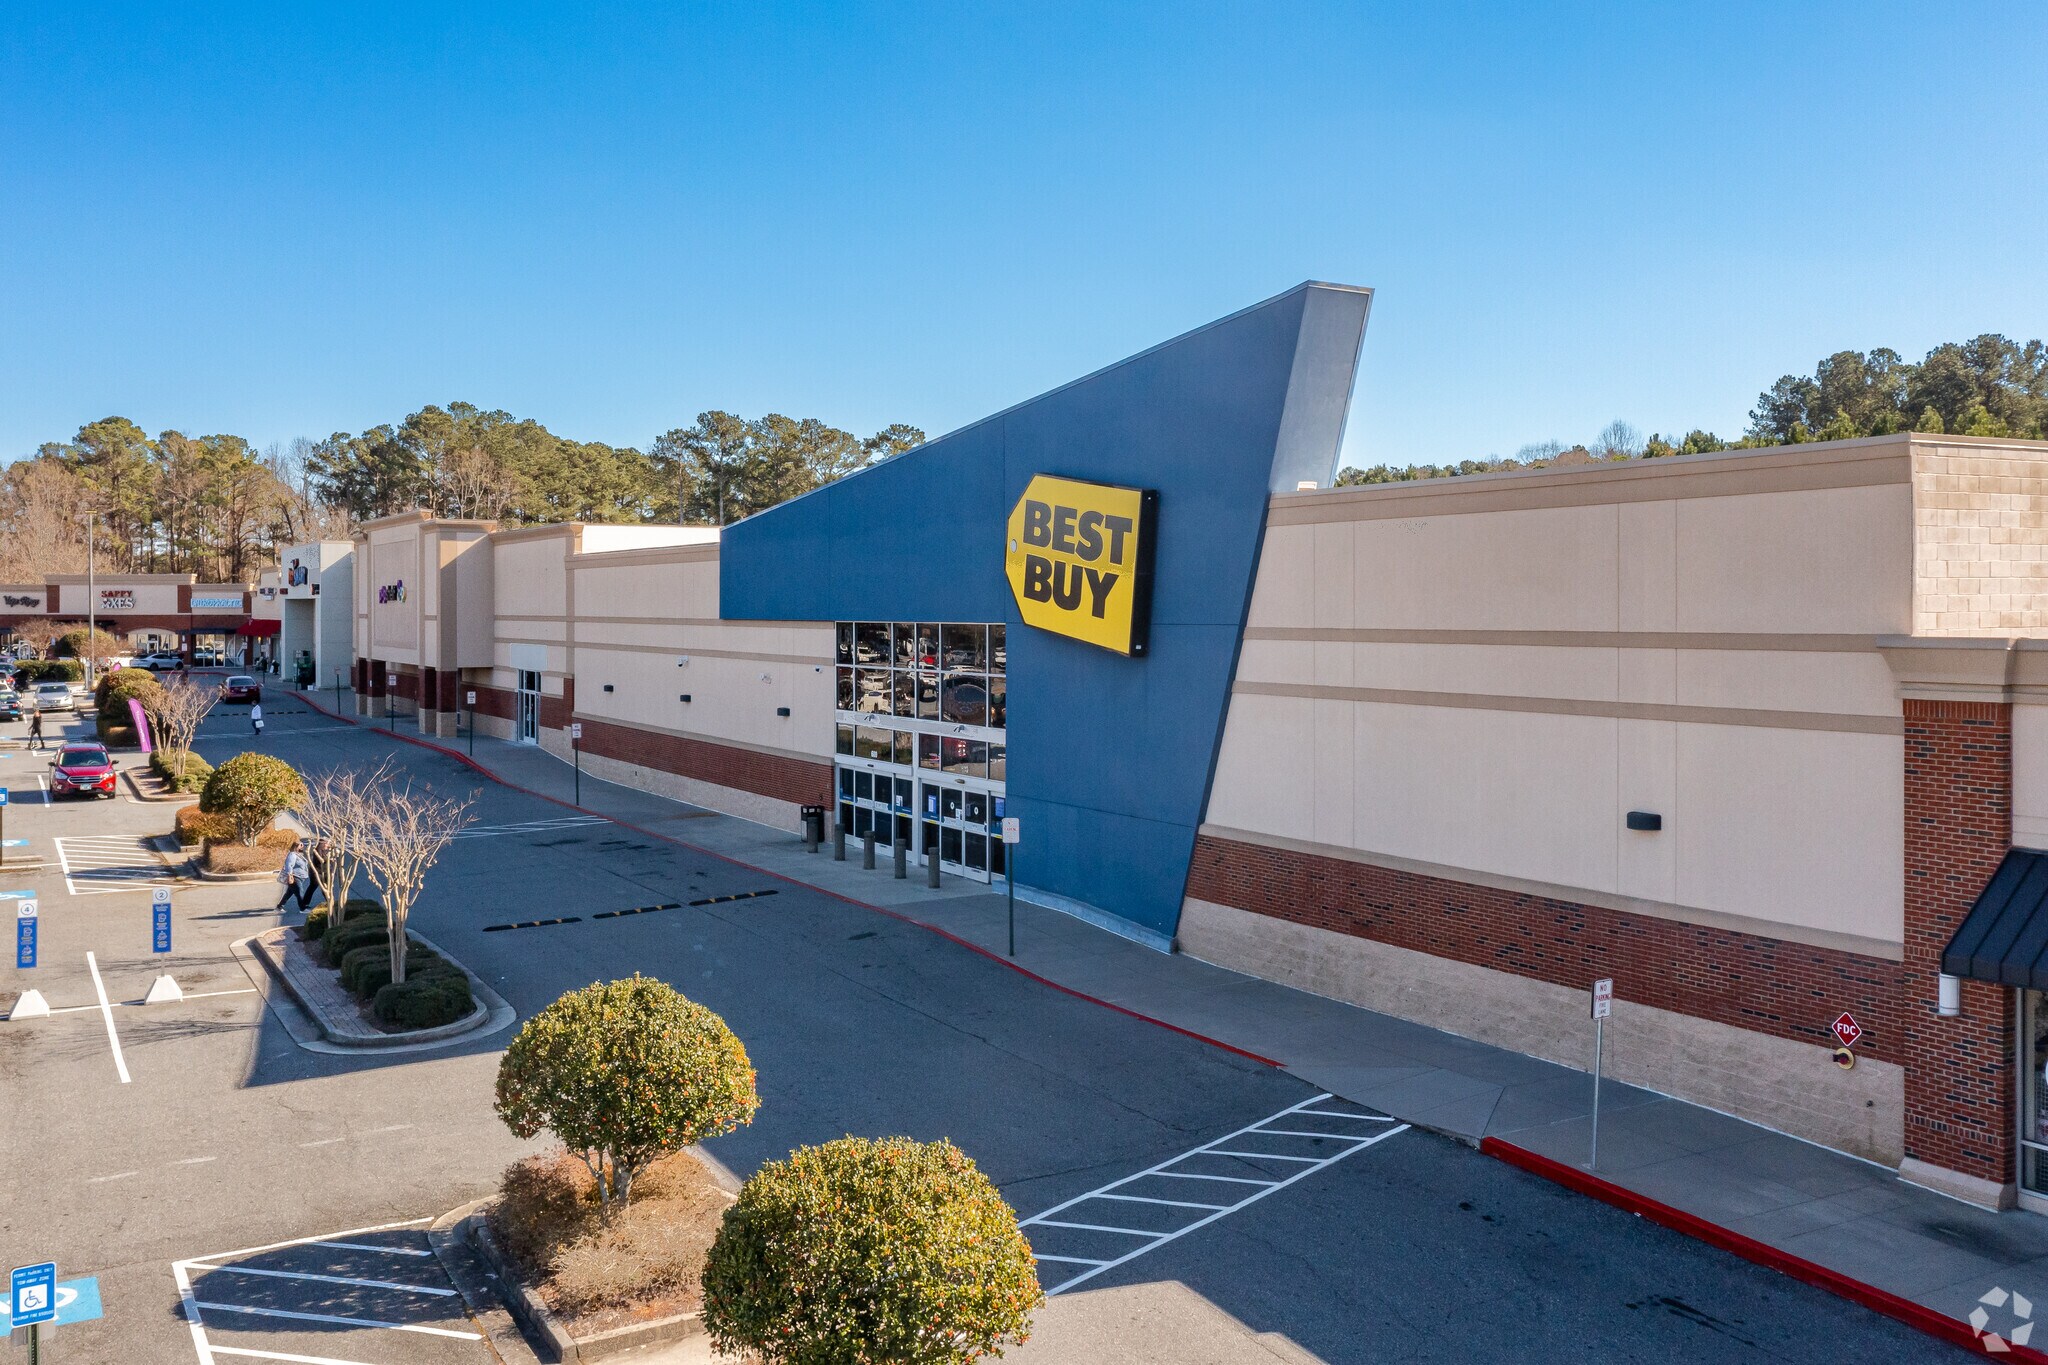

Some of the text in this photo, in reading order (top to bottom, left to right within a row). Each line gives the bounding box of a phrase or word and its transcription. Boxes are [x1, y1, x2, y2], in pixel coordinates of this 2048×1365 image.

[1023, 499, 1133, 566] BEST
[101, 590, 132, 598] SAPPY
[1023, 553, 1120, 620] BUY
[1836, 1023, 1856, 1036] FDC
